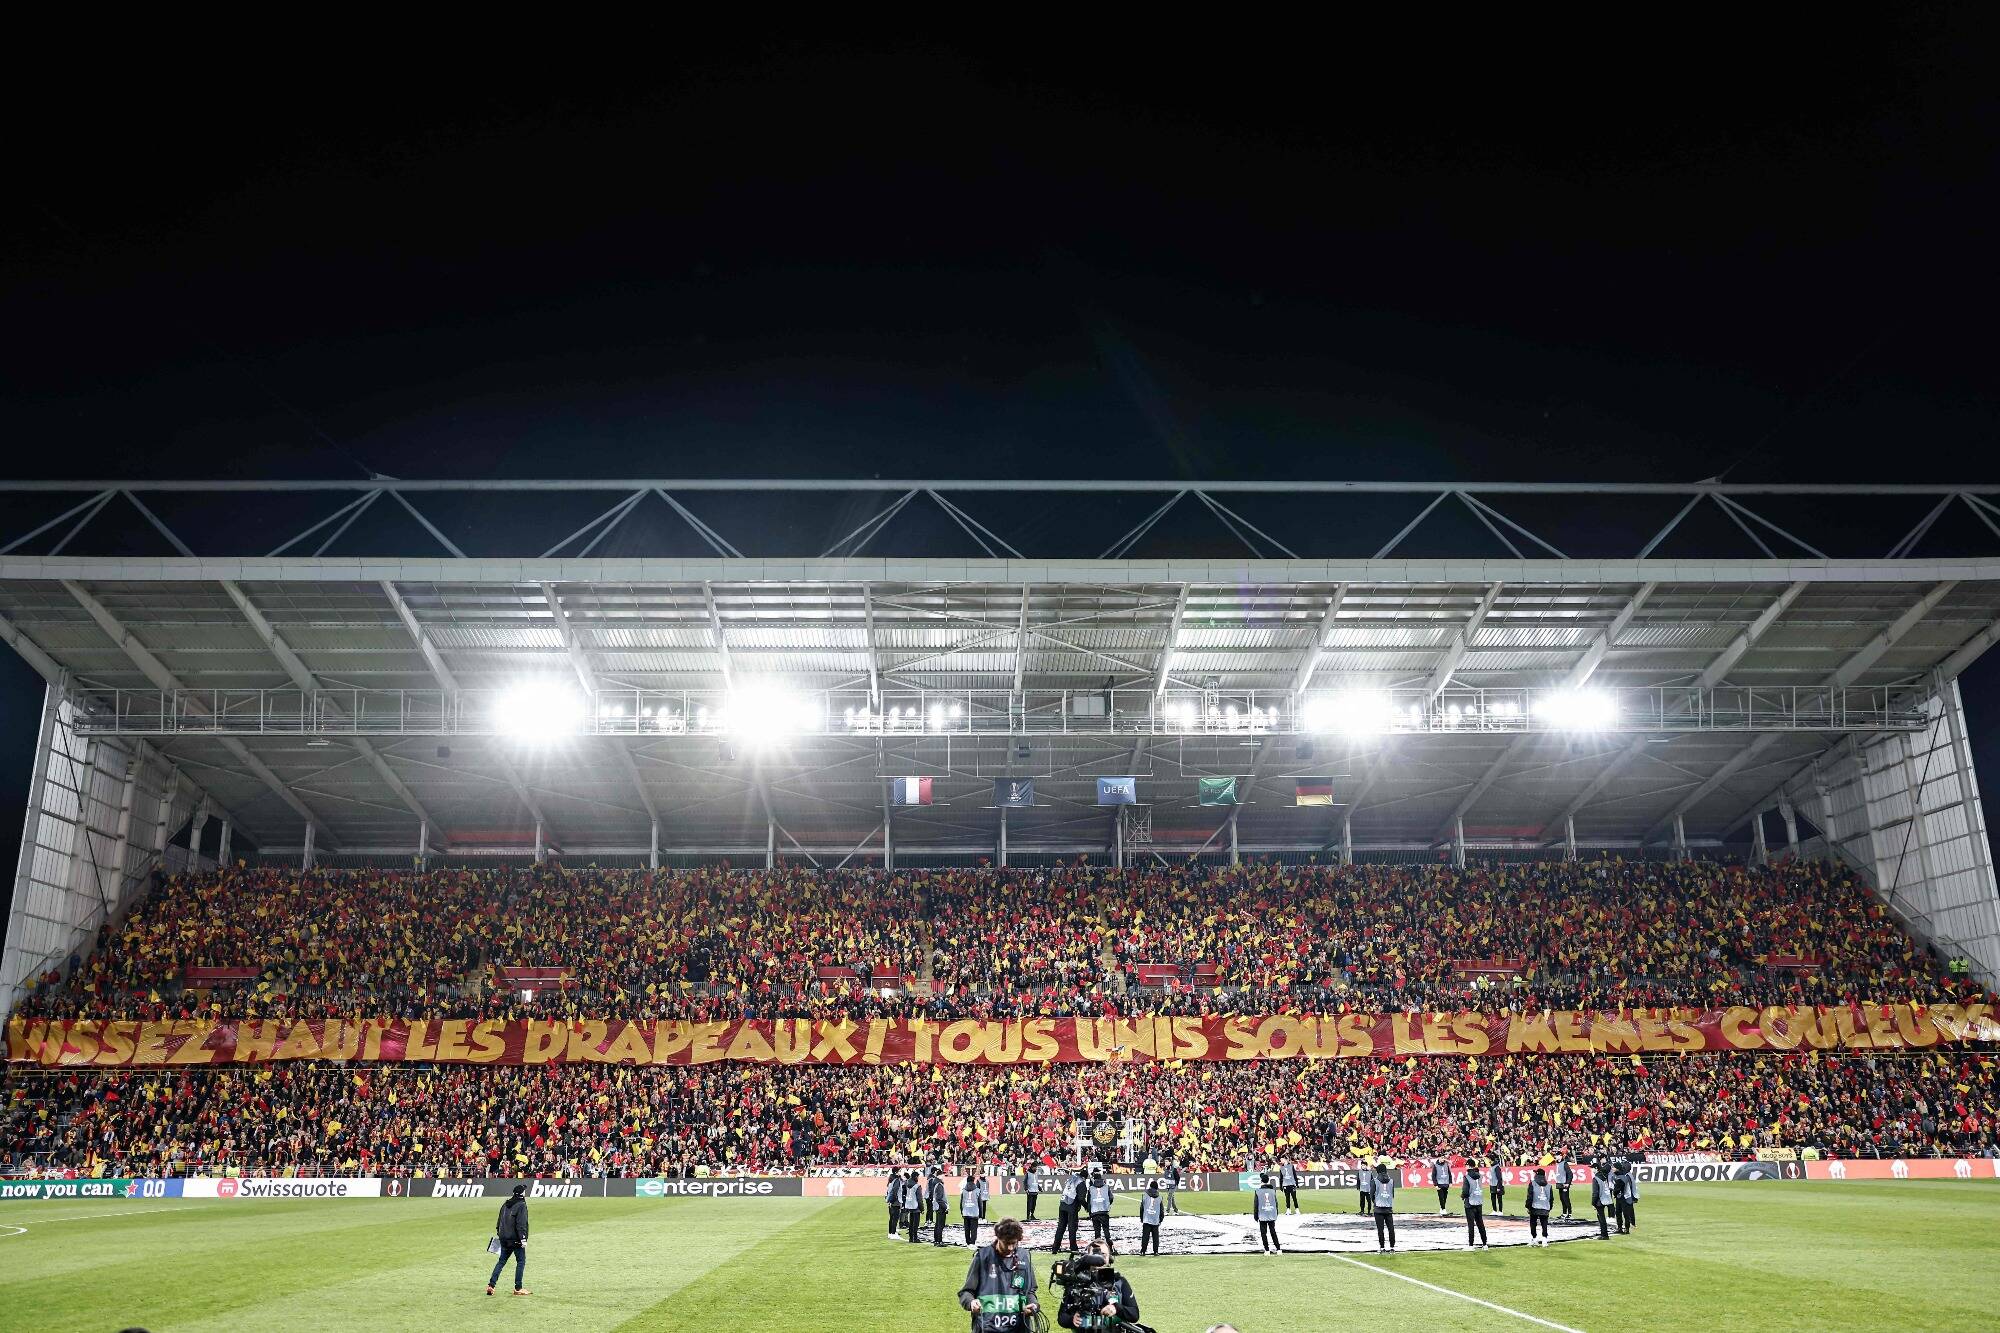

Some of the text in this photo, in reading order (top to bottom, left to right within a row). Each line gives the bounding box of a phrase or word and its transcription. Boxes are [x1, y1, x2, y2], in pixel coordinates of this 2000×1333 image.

[1103, 785, 1130, 795] UEFA
[233, 1018, 396, 1061] HAUT
[404, 1019, 507, 1063] LES
[907, 1018, 1060, 1064] TOUS
[1074, 1017, 1211, 1061] UNIS
[1223, 1014, 1375, 1060] SOUS
[1391, 1012, 1491, 1056] LES
[1506, 1008, 1706, 1053] MEMES
[241, 1178, 348, 1197] Swissquote
[432, 1178, 485, 1197] bwin
[530, 1178, 583, 1197] bwin
[643, 1177, 774, 1197] enterprise
[1128, 1177, 1187, 1191] LEAGE
[1247, 1170, 1358, 1190] enrpris
[1, 1183, 114, 1199] now you can
[995, 1296, 1015, 1311] HB
[994, 1314, 1017, 1328] 026
